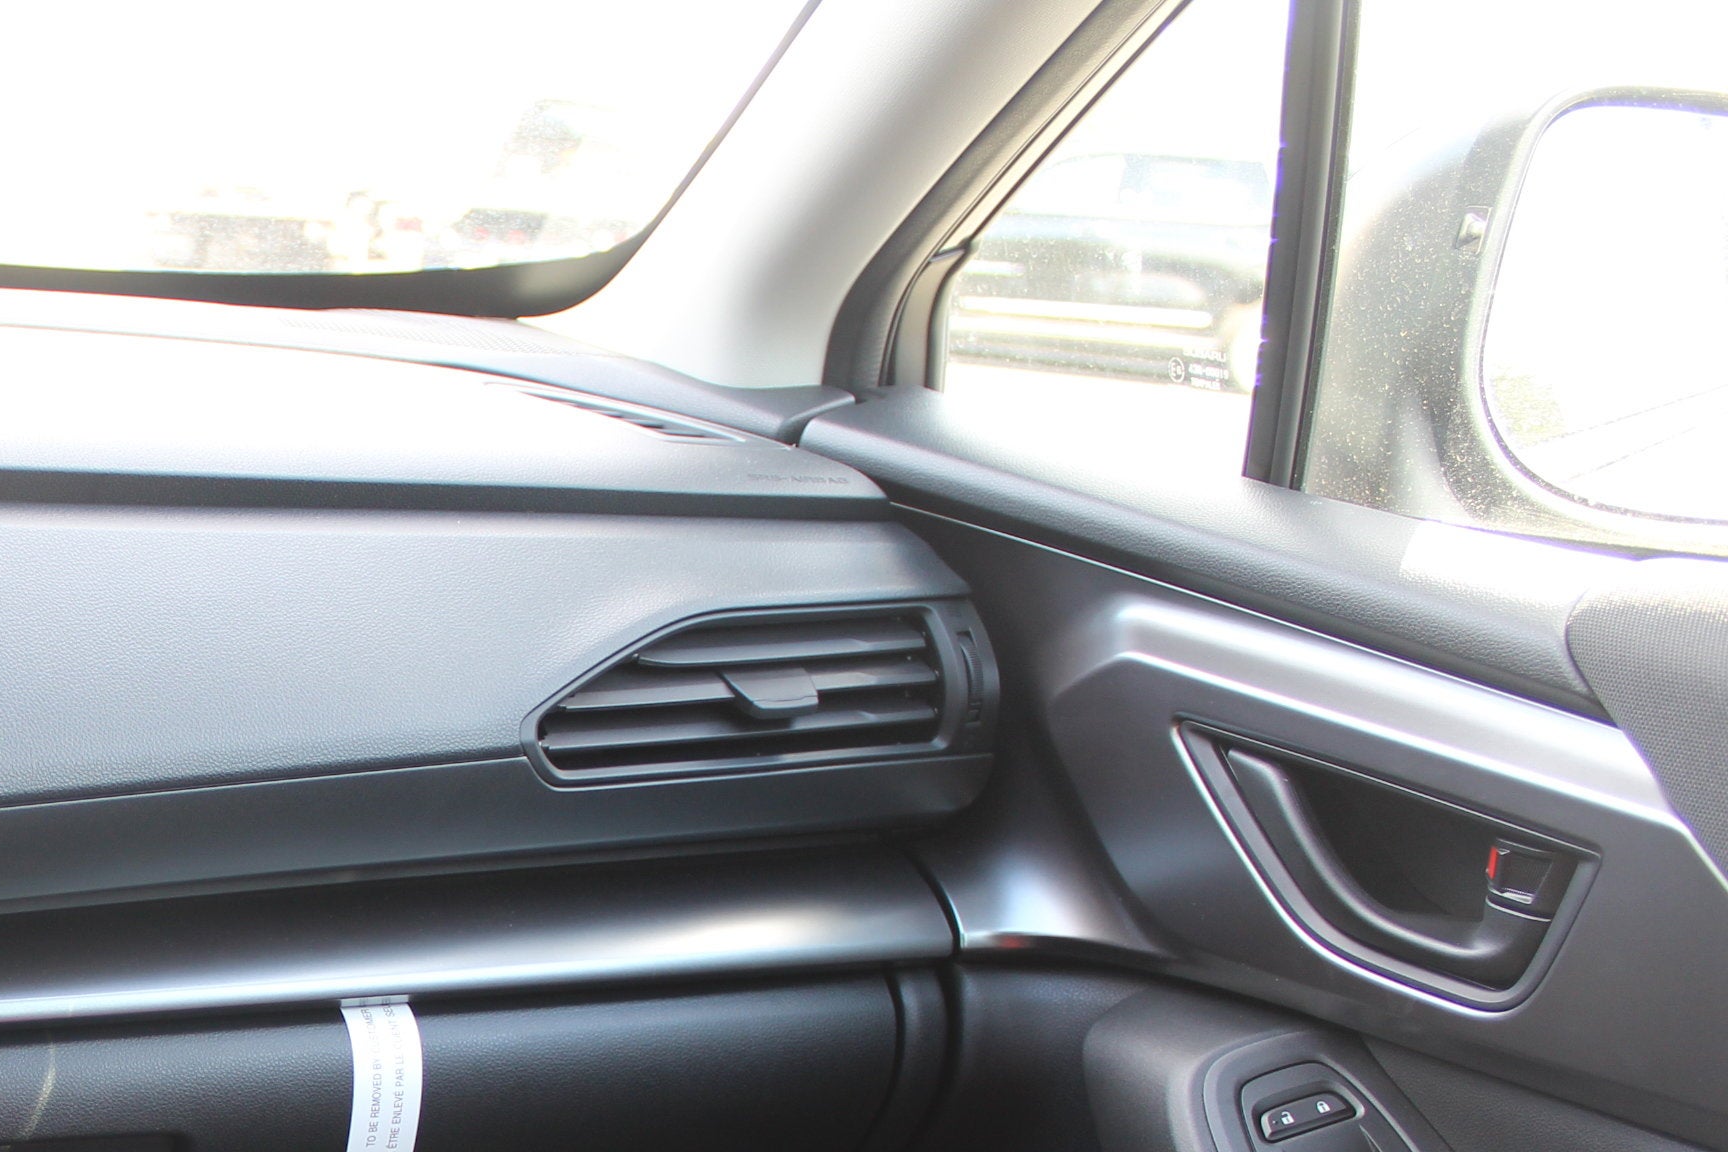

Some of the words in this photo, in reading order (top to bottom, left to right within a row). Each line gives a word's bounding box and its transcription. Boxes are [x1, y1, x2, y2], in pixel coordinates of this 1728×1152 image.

[370, 1073, 382, 1118] REMOVED
[368, 1121, 379, 1133] BE
[366, 1135, 377, 1148] TO
